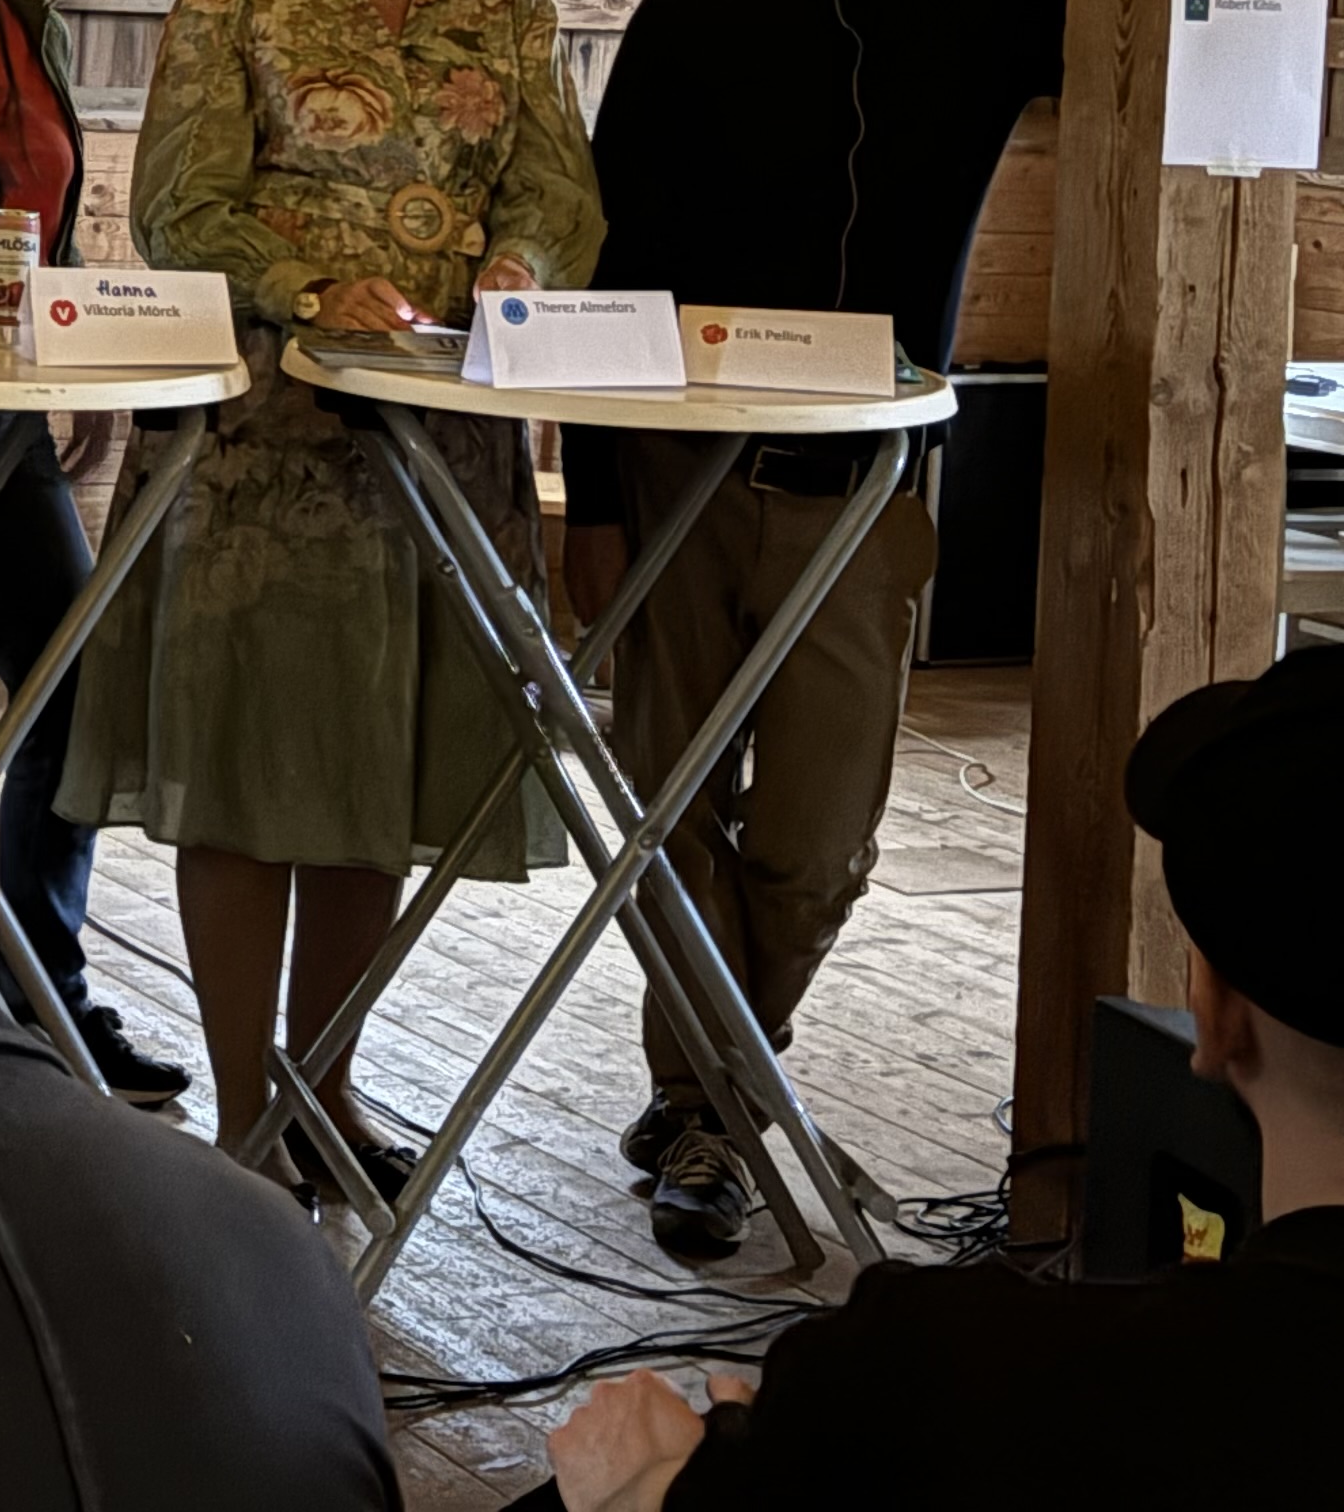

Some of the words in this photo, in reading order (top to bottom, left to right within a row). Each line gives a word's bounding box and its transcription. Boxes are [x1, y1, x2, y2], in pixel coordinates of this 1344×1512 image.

[96, 279, 158, 298] Hanna
[82, 303, 135, 317] Viktoria
[138, 304, 181, 318] Mörck
[533, 300, 576, 313] Therez
[735, 327, 762, 340] Erik
[765, 329, 812, 345] Pelling
